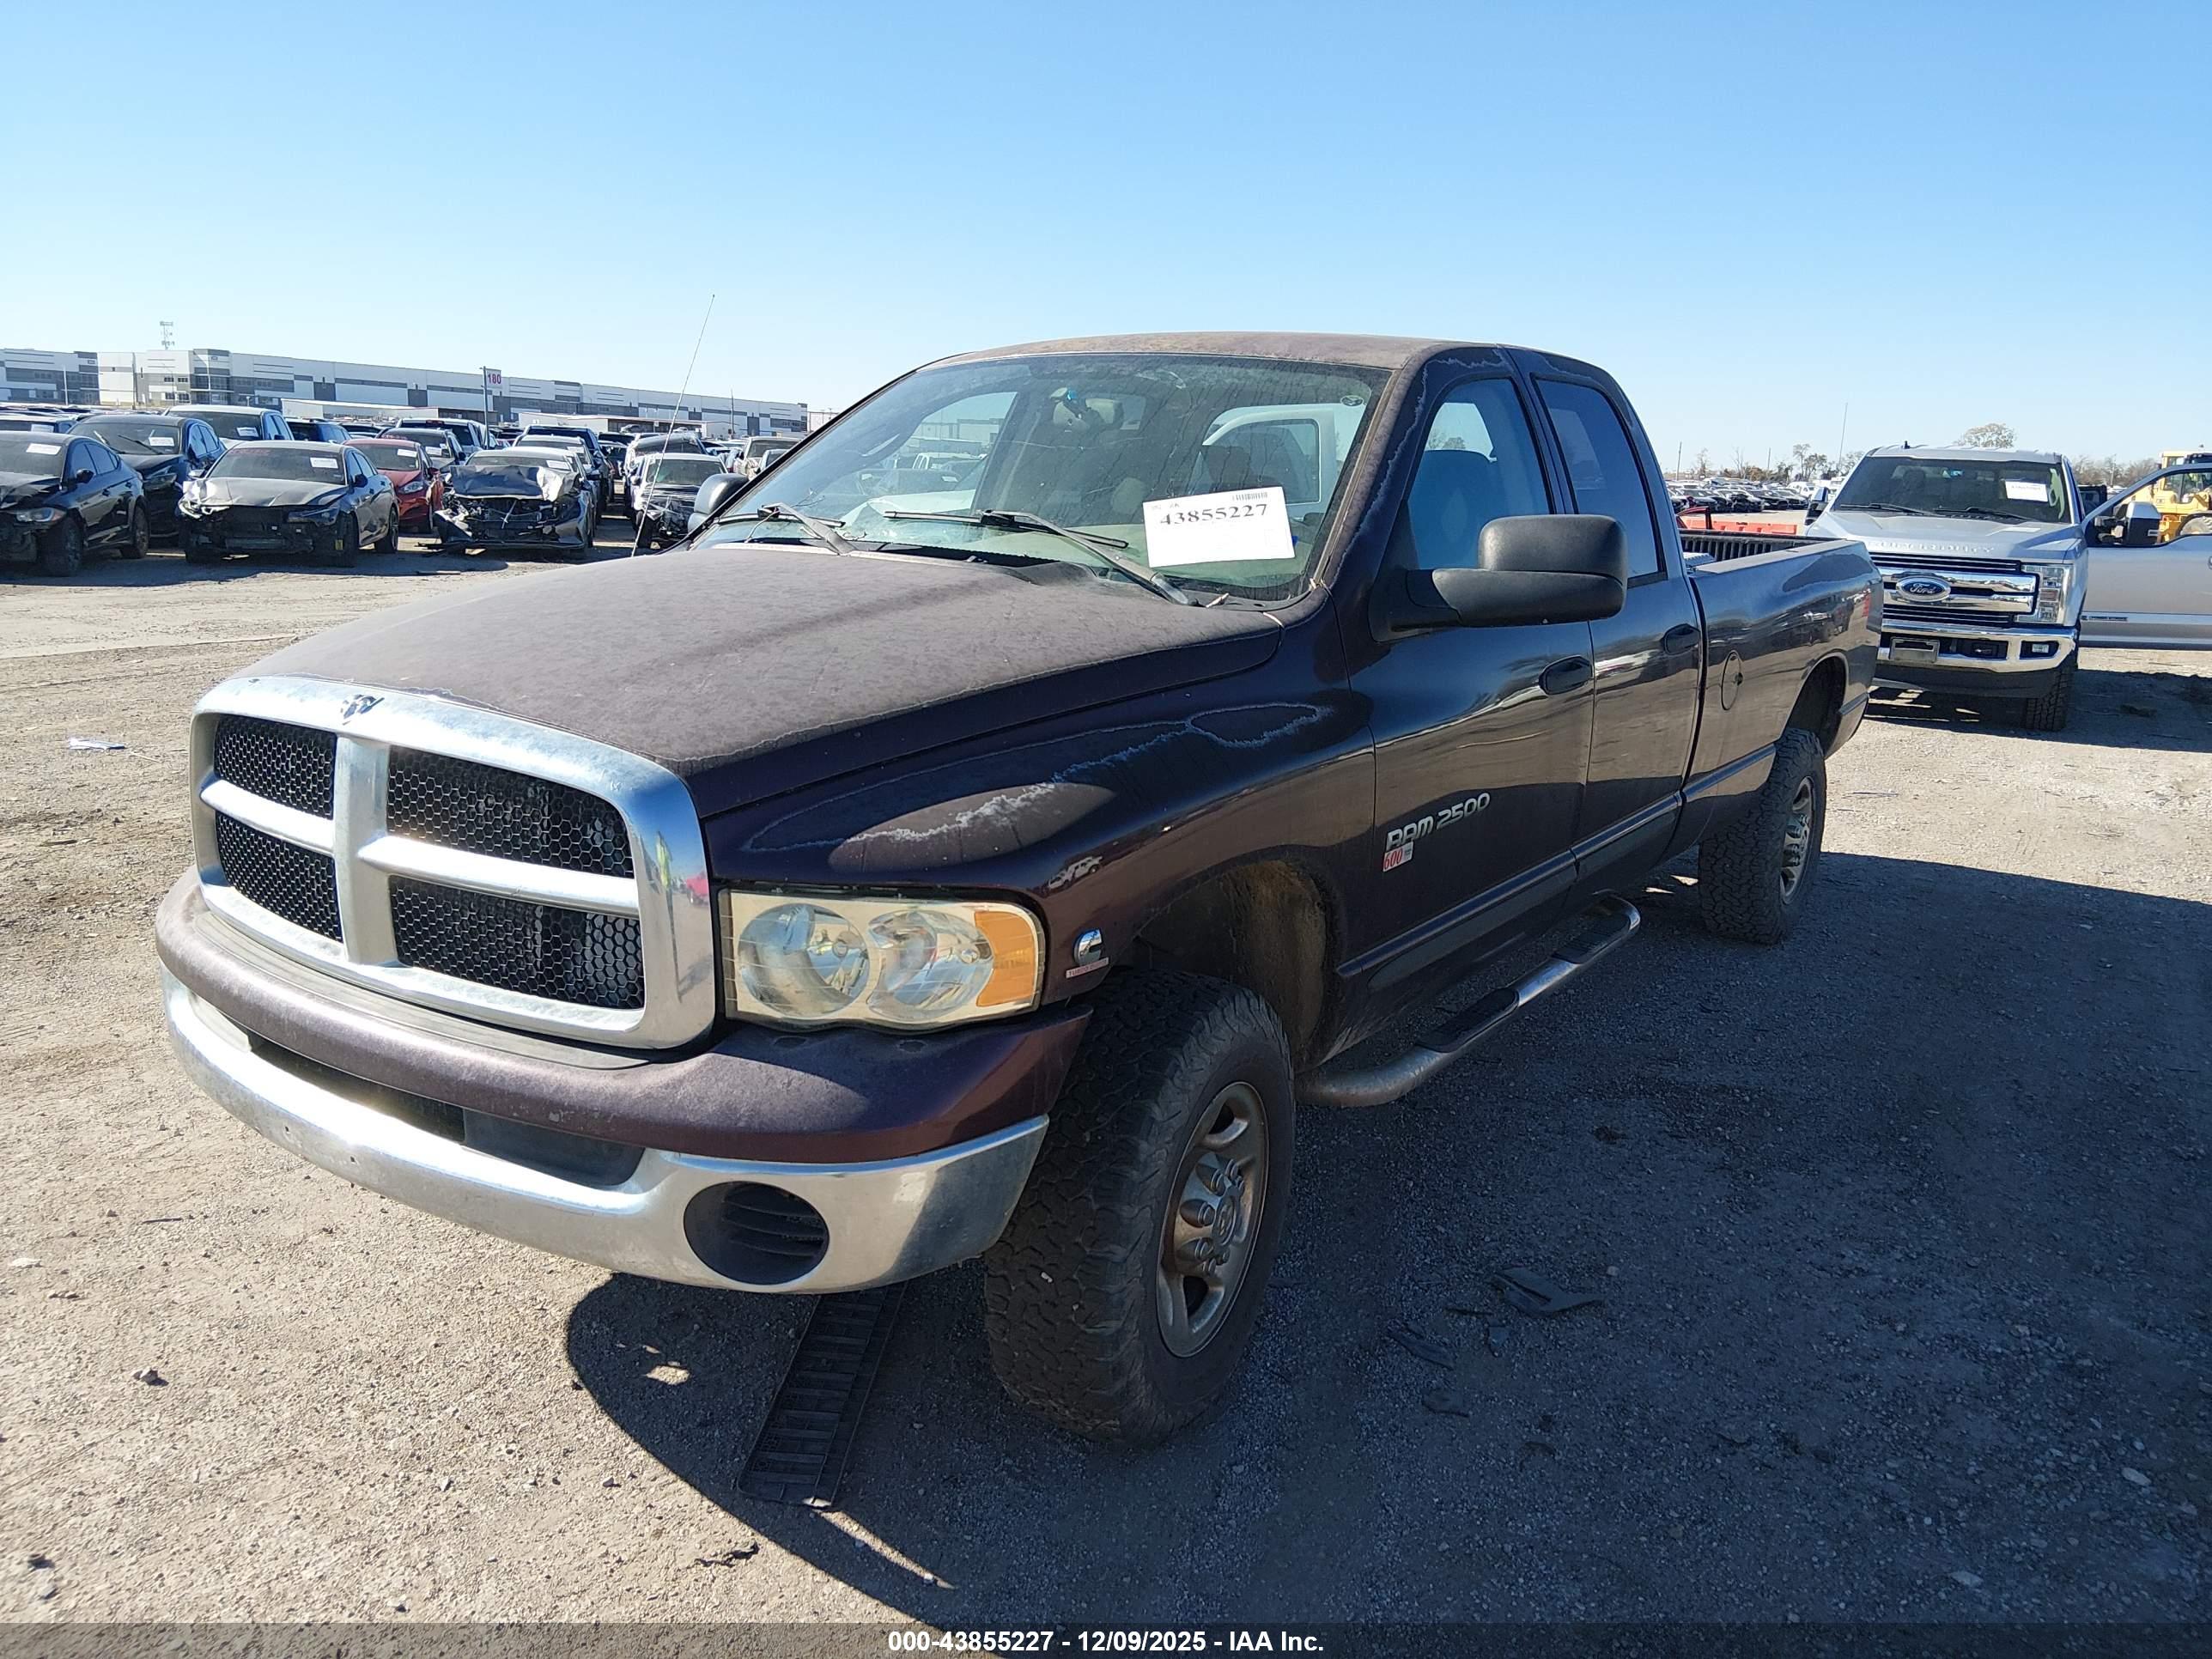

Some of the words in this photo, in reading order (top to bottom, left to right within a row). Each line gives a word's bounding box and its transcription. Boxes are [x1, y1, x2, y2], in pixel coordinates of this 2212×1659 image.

[488, 374, 501, 384] 180
[1160, 503, 1267, 525] 43855227
[1909, 582, 1936, 594] Ford
[1386, 816, 1434, 851] RAM
[1436, 793, 1491, 830] 2500
